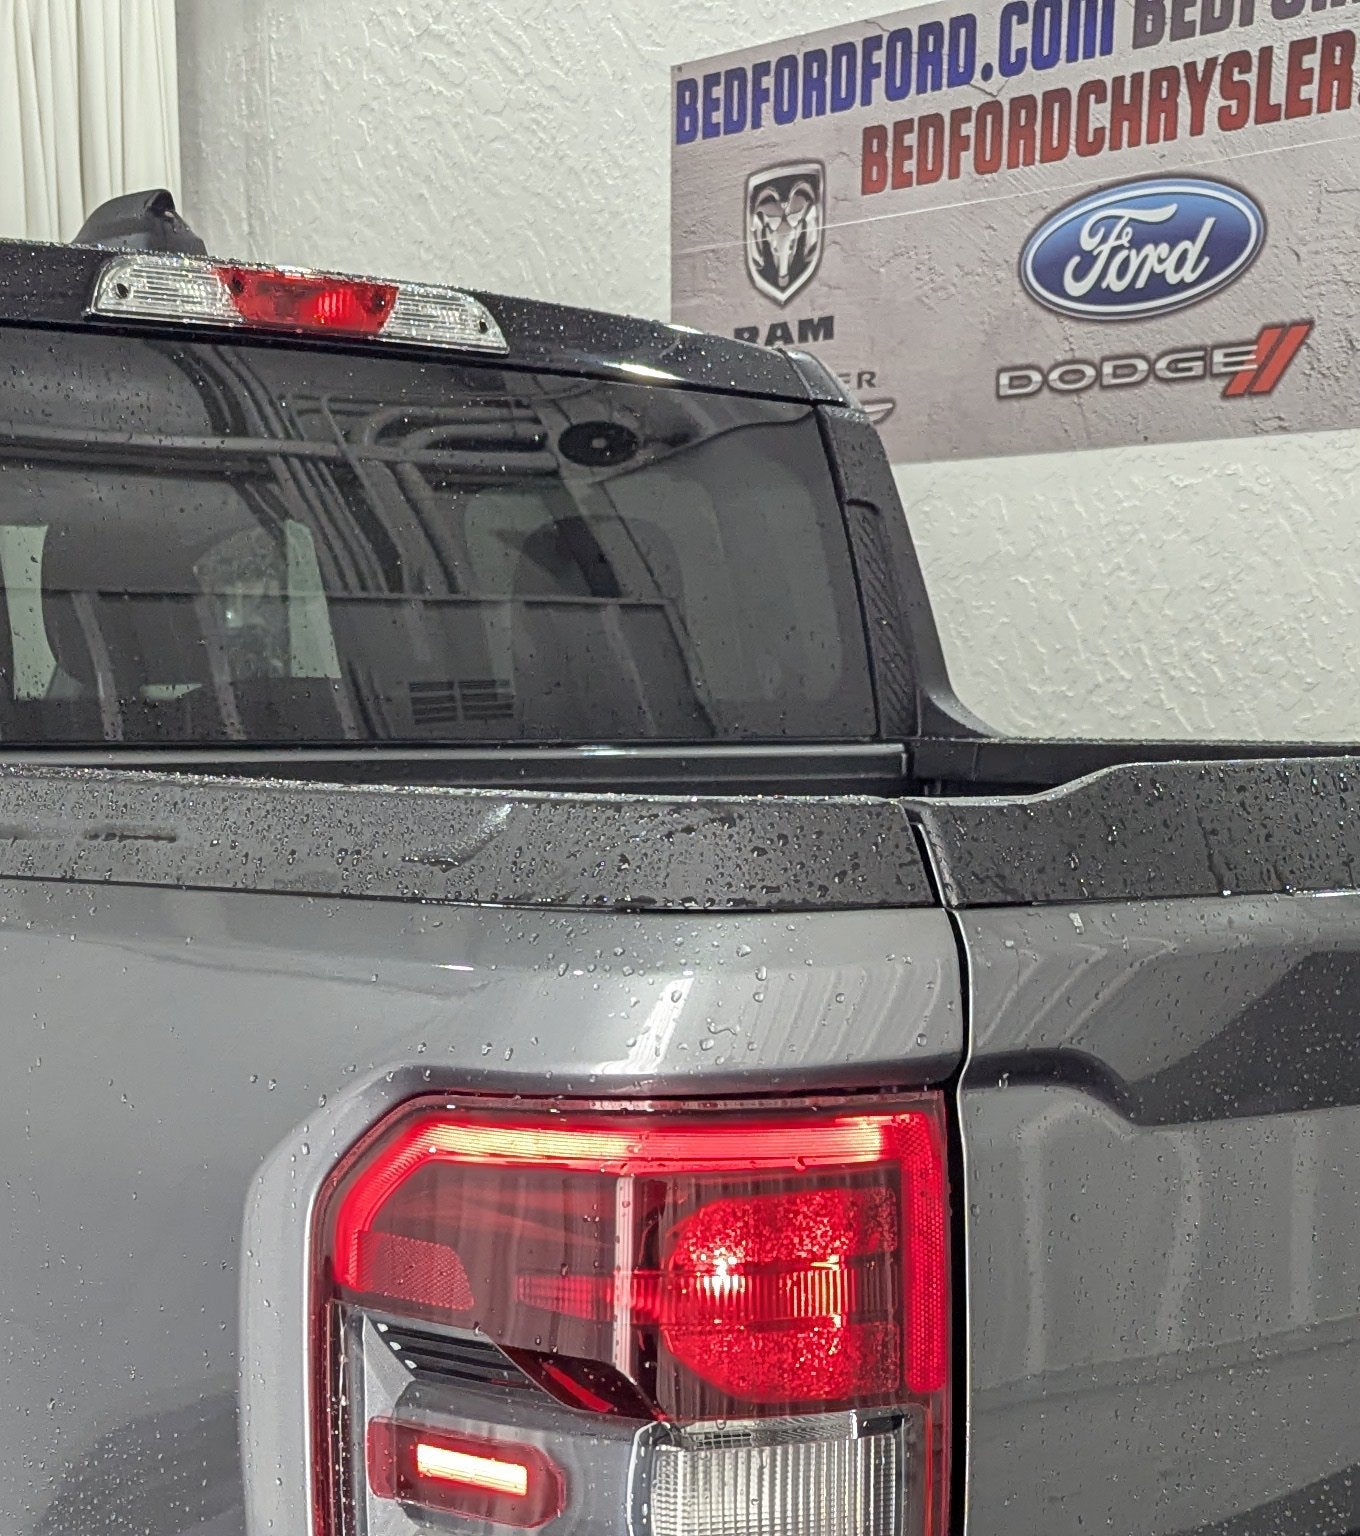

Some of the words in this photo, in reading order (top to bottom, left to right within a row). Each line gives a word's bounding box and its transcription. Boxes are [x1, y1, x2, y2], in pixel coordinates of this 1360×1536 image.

[675, 0, 1114, 145] BEDFORDFORD.COM
[1063, 203, 1217, 291] Ford
[996, 342, 1260, 399] DODGE
